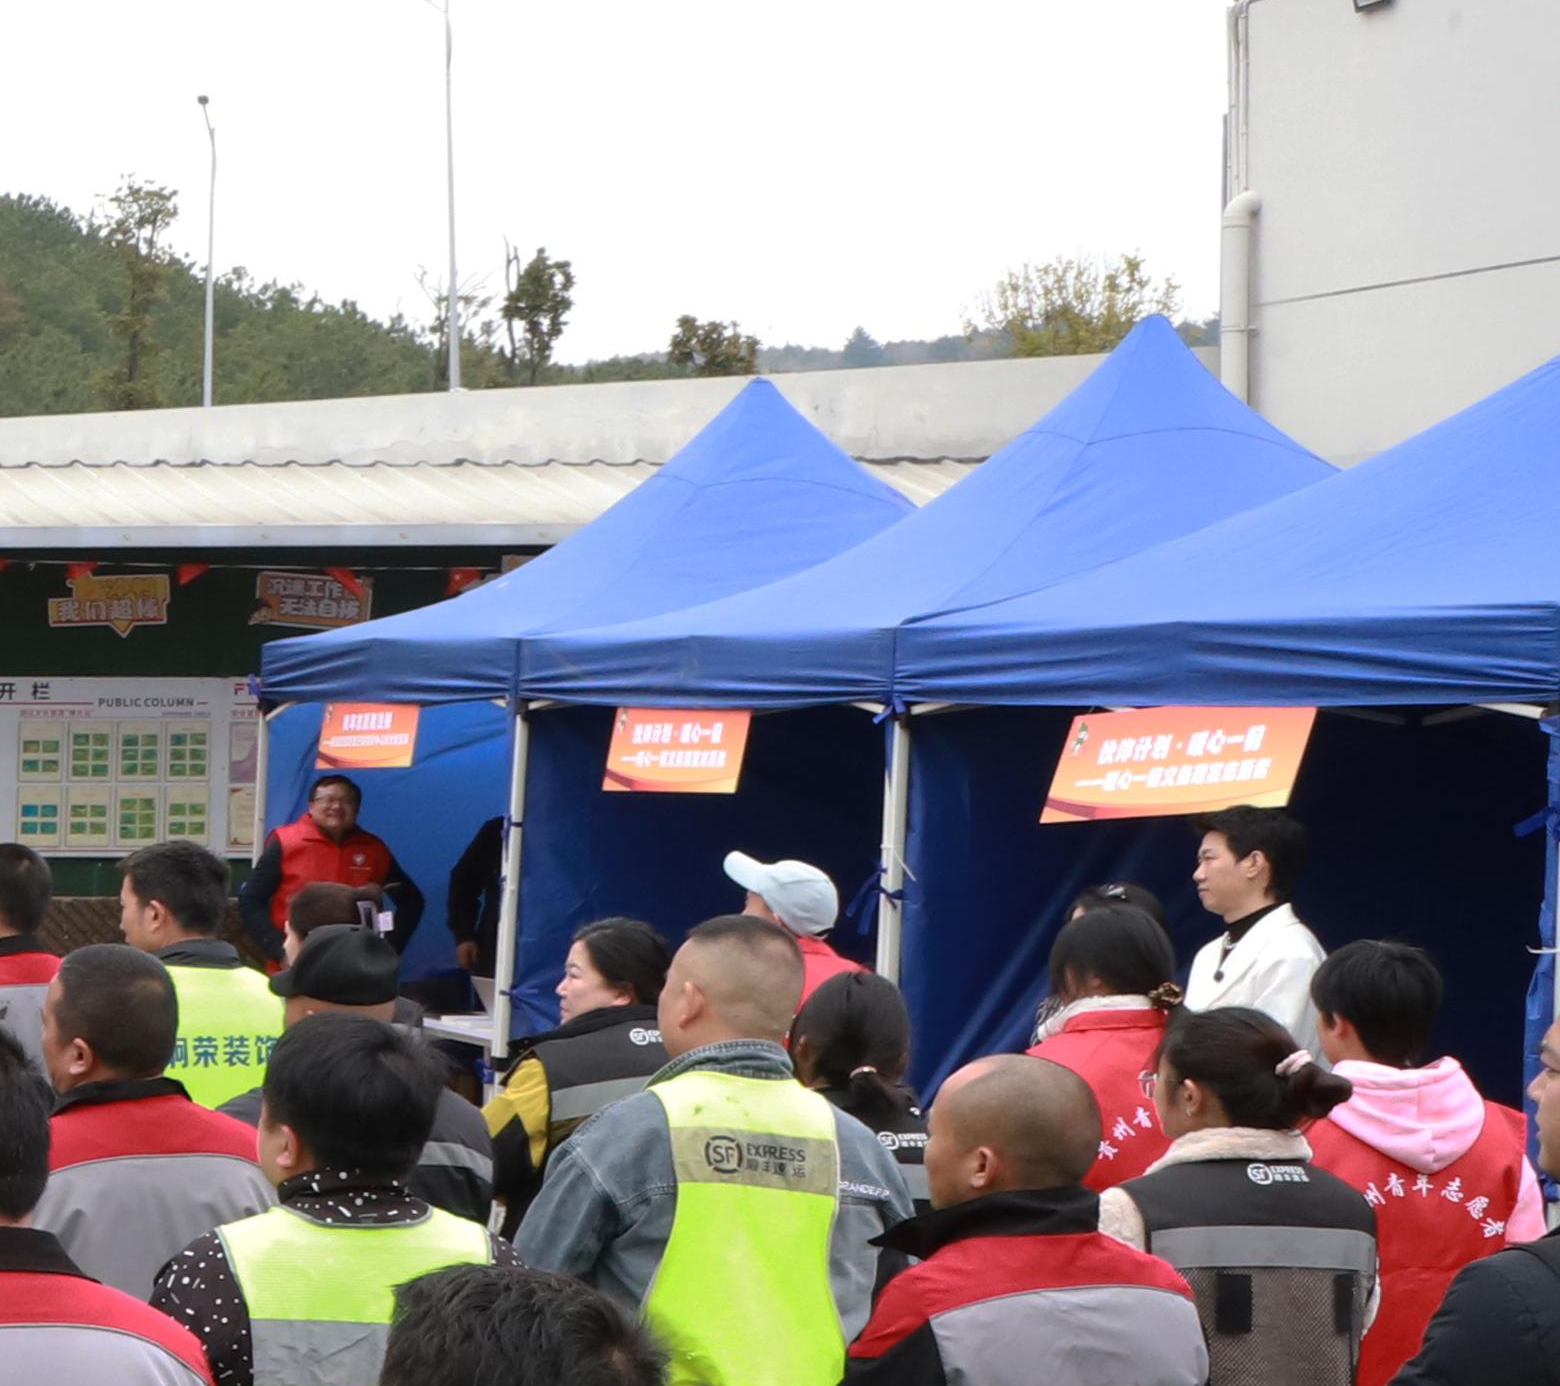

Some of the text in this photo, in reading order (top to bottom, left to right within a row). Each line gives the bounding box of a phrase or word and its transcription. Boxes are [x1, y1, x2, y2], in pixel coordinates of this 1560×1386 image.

[98, 697, 194, 708] PUBLIC COLUMN
[746, 1142, 807, 1163] EXPRESS
